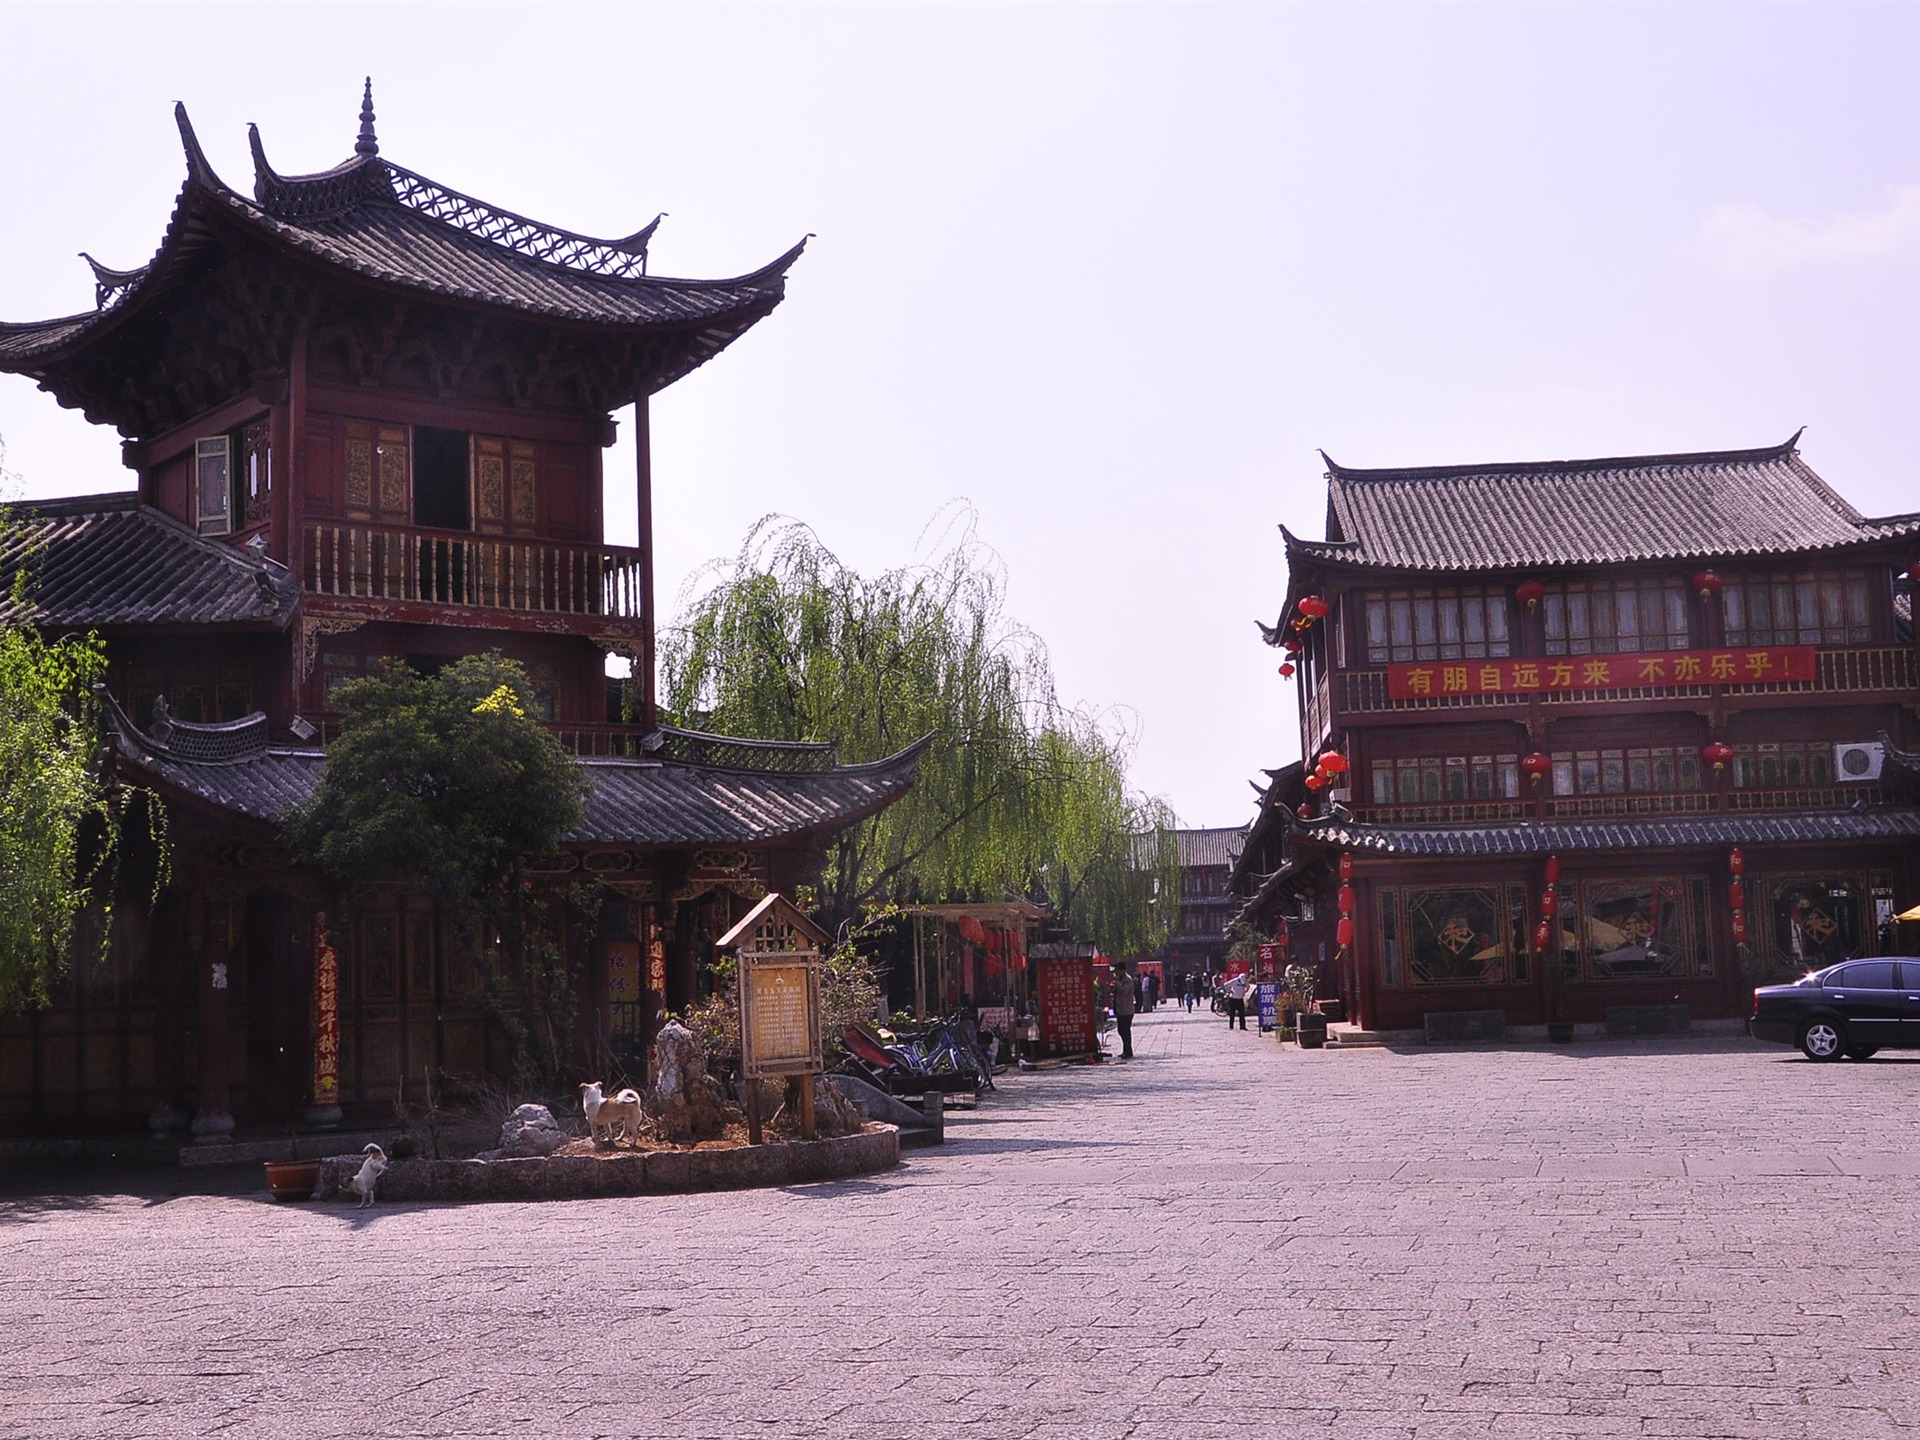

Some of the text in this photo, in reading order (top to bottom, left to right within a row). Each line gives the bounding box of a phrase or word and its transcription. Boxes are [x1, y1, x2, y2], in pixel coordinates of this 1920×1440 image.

[1407, 660, 1610, 694] 有朋自远方来
